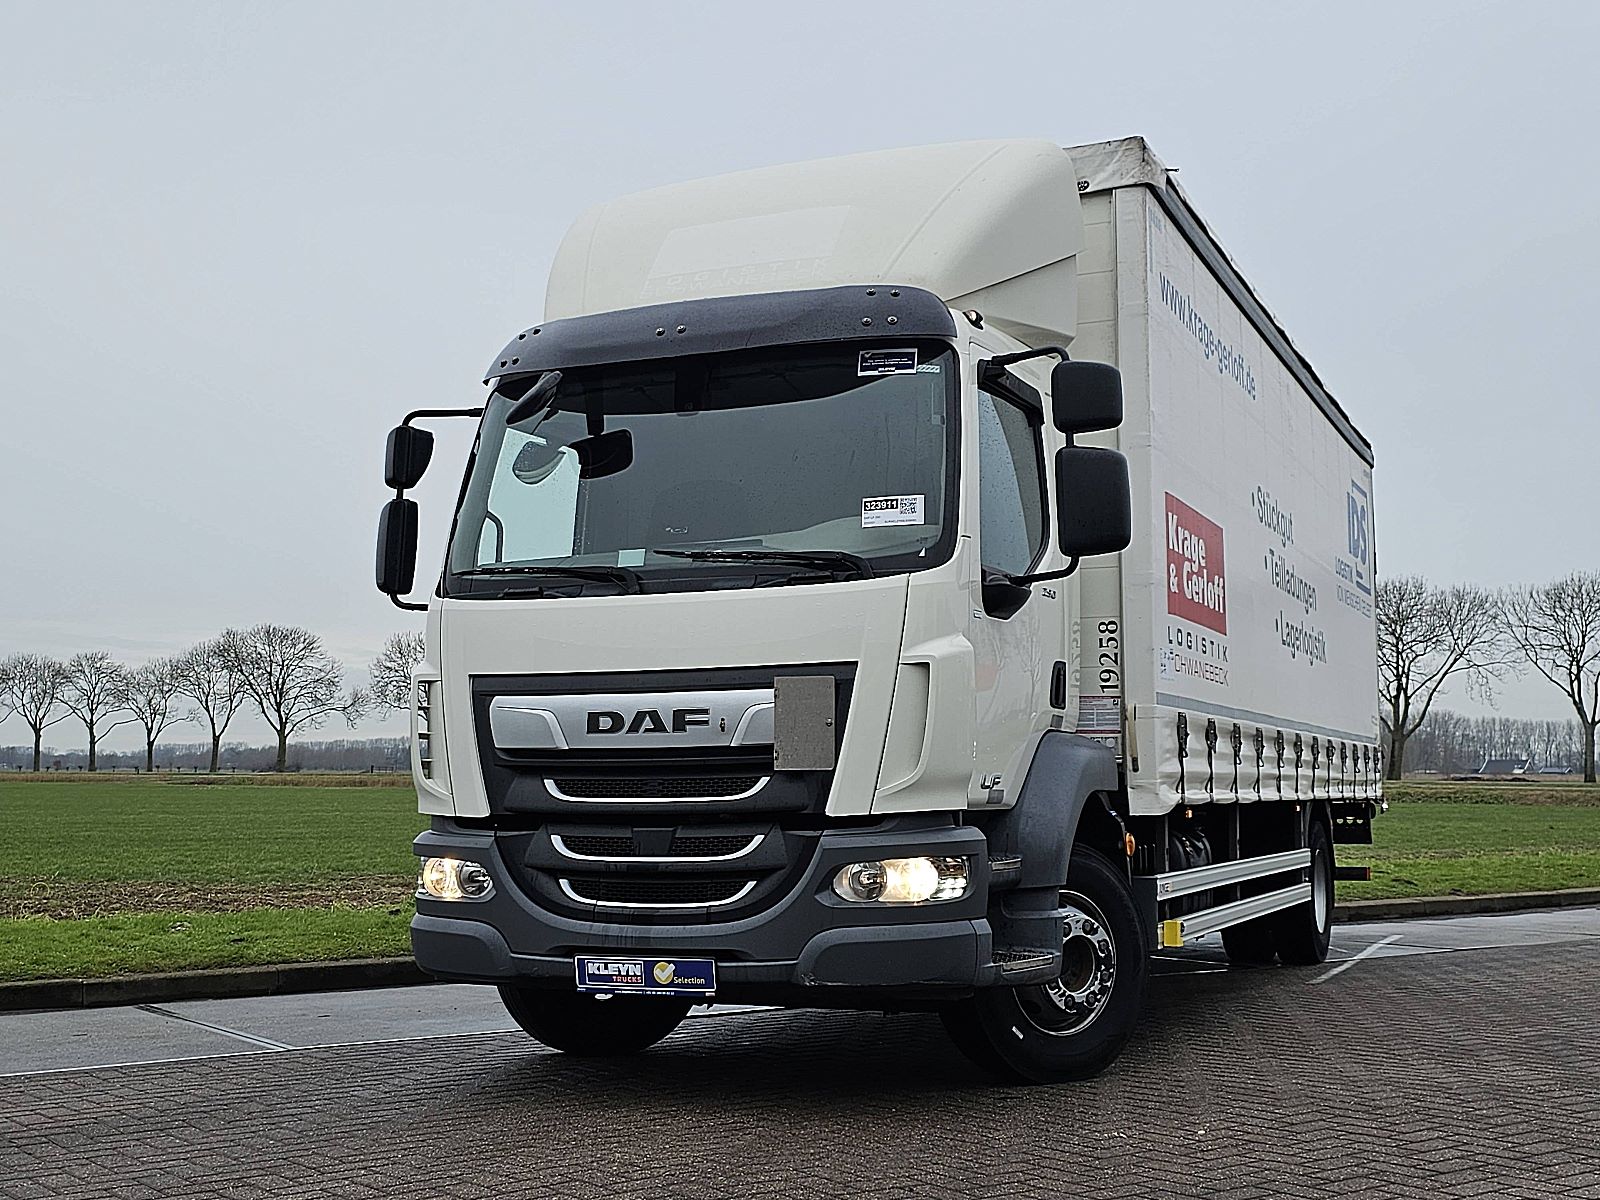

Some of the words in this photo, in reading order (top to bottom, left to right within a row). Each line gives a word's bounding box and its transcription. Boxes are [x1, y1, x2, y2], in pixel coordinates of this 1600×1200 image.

[1158, 271, 1256, 401] www.krage-gerloff.de
[865, 500, 897, 511] 323911
[1257, 485, 1294, 548] Stückgut
[1167, 511, 1206, 573] Krage
[1169, 563, 1179, 593] &
[1182, 560, 1224, 614] Gerloff
[1269, 547, 1318, 616] Teilladungen
[1098, 620, 1119, 694] 19258
[1167, 625, 1229, 663] LOGISTIK
[1280, 609, 1327, 667] Lagerlogistik
[1168, 650, 1229, 687] CHWANEBECK
[586, 707, 710, 735] DAF
[980, 773, 1002, 790] LF
[587, 962, 641, 976] KLEYN
[612, 975, 642, 983] TRUCKS
[673, 976, 705, 985] Selection
